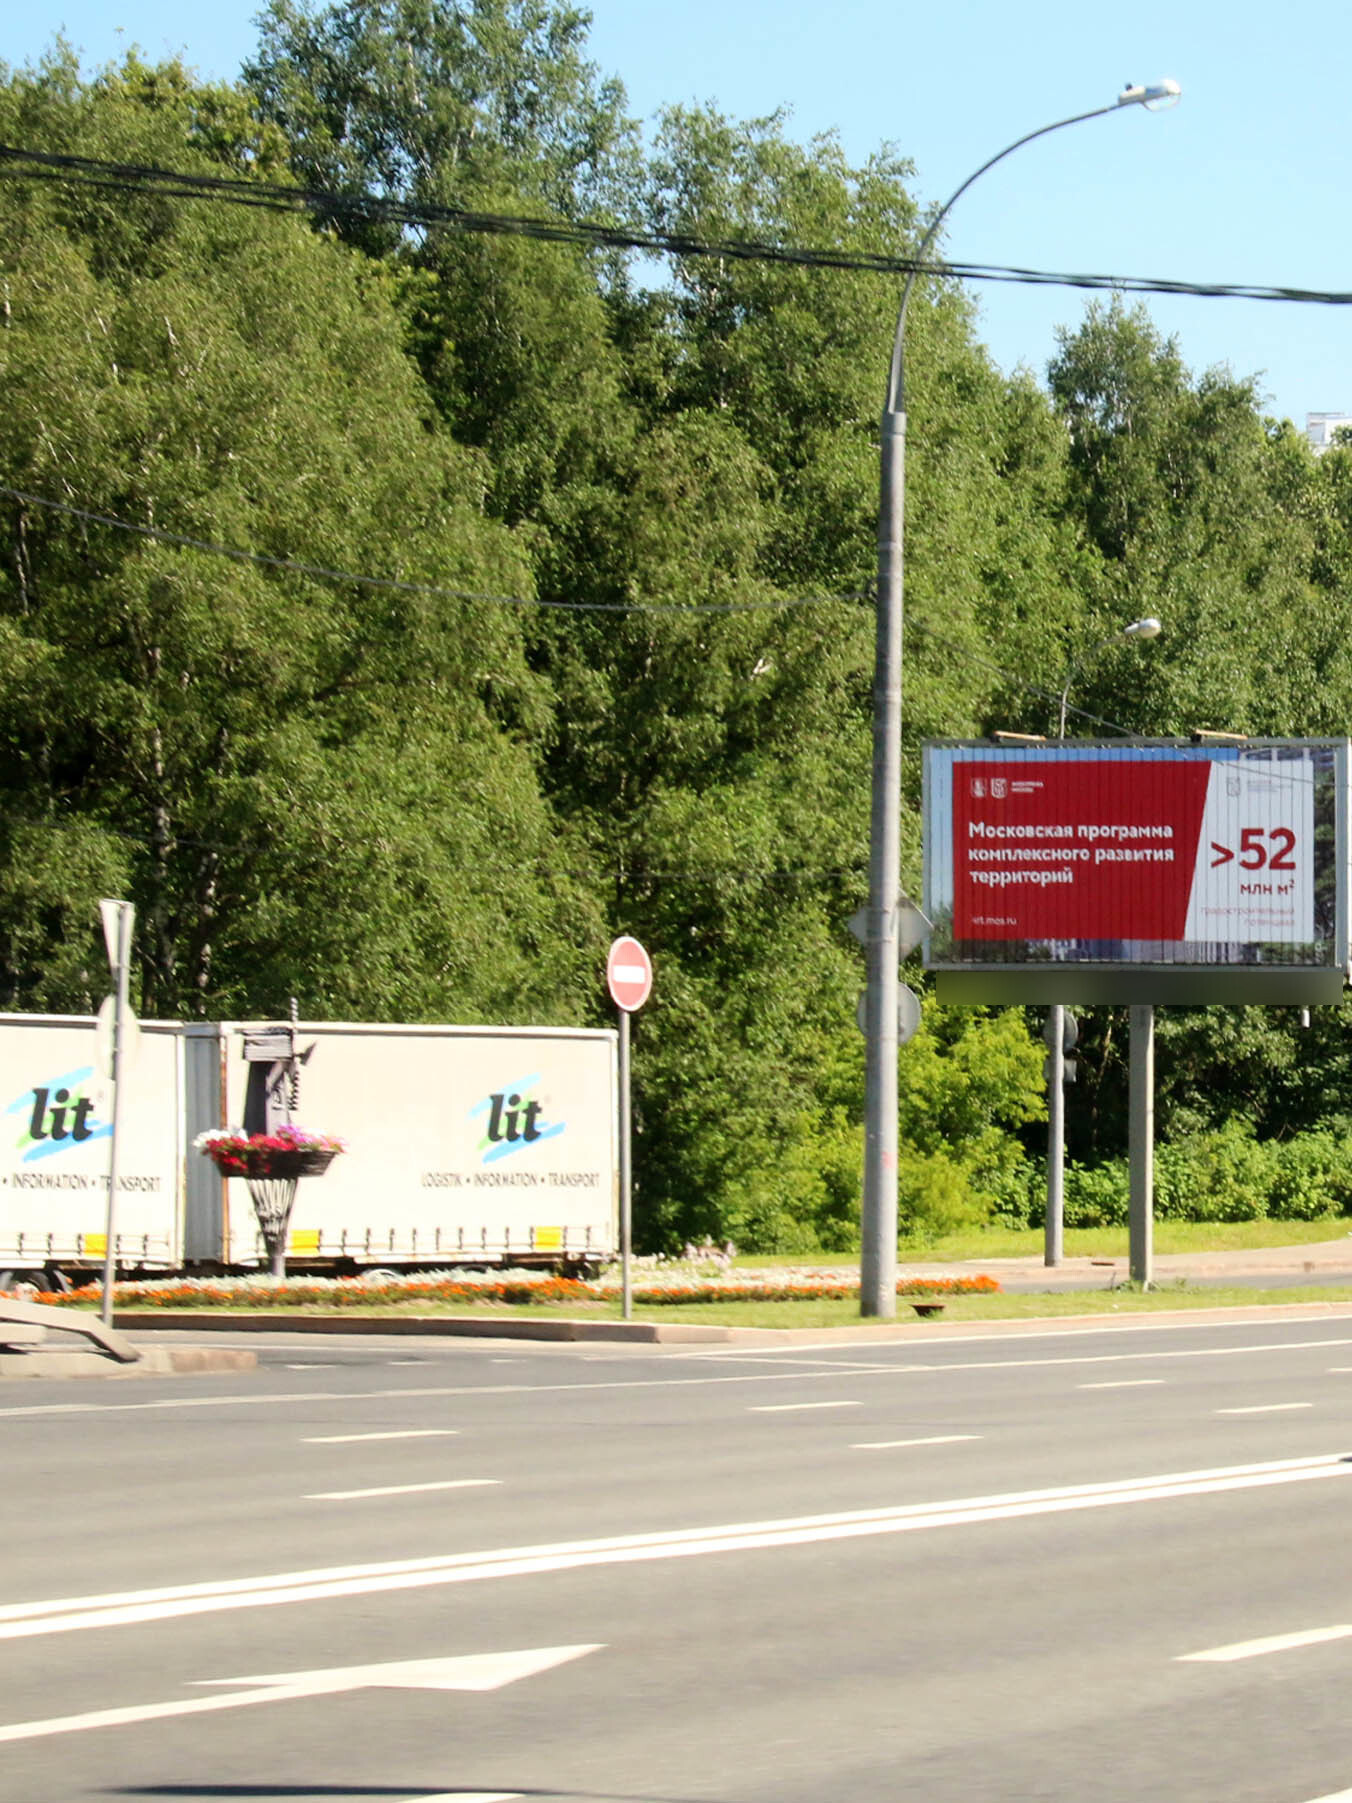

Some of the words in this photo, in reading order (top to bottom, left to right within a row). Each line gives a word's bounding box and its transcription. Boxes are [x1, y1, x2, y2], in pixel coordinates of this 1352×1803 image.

[968, 822, 1073, 838] Московская
[1078, 825, 1173, 841] программа
[968, 849, 1090, 862] комплексного
[1095, 849, 1174, 864] развития
[1211, 827, 1296, 871] >52
[969, 867, 1073, 888] территорий
[1240, 884, 1272, 895] млн
[29, 1088, 95, 1142] lit
[487, 1094, 543, 1142] lit
[12, 1173, 88, 1190] INFORMATION
[473, 1172, 538, 1188] INFORMATION
[548, 1172, 600, 1188] TRANSPORT
